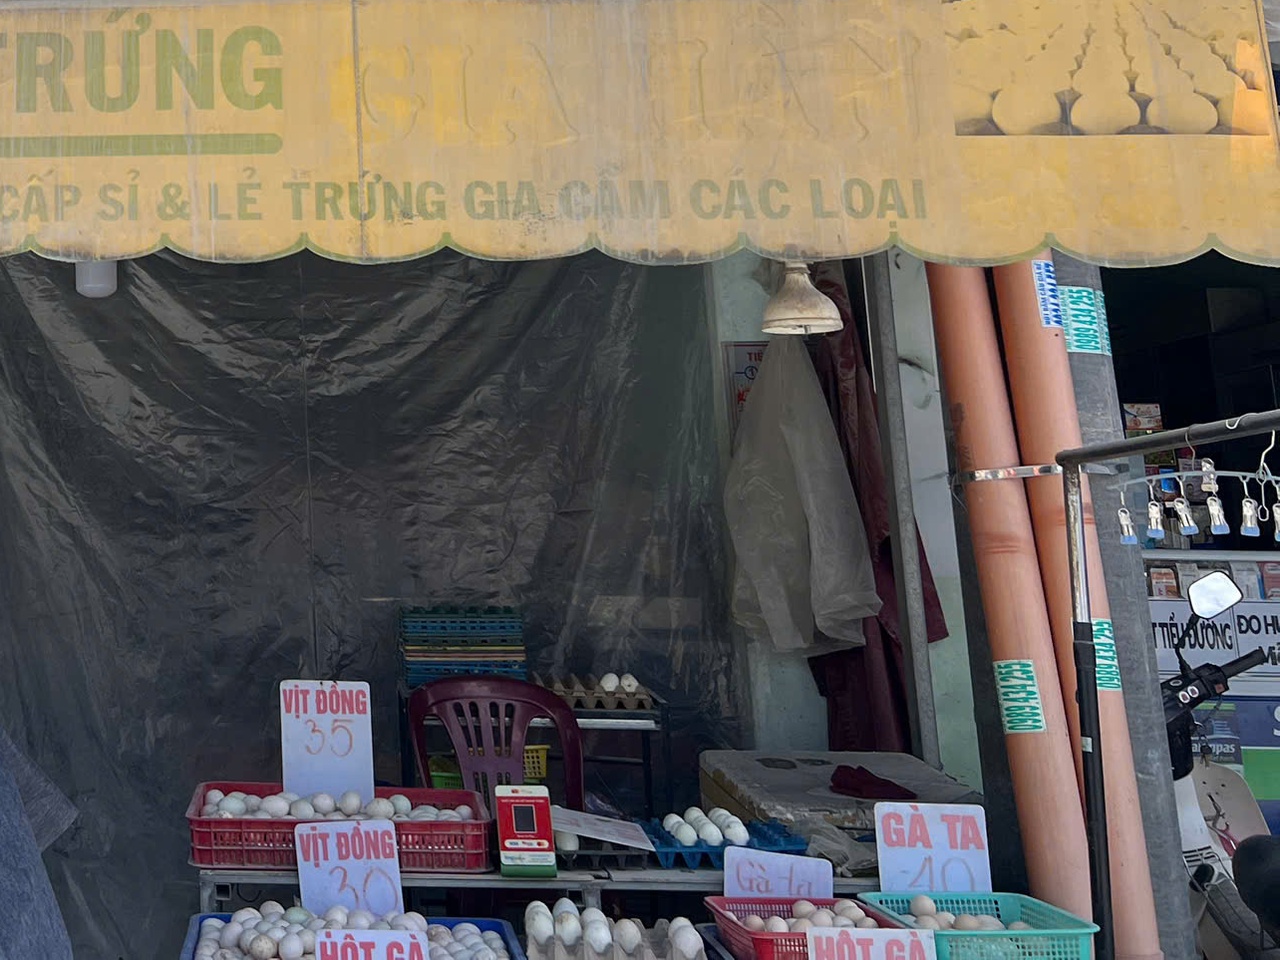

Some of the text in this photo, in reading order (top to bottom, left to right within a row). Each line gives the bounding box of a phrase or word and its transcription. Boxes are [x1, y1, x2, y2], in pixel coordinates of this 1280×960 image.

[156, 181, 190, 221] &
[463, 180, 540, 221] GIA
[810, 178, 928, 229] LOẠI
[283, 681, 367, 719] VỊT ĐỒNG
[305, 718, 354, 757] 35
[299, 821, 395, 868] VỊT ĐỒNG
[881, 805, 986, 851] GÀ TA
